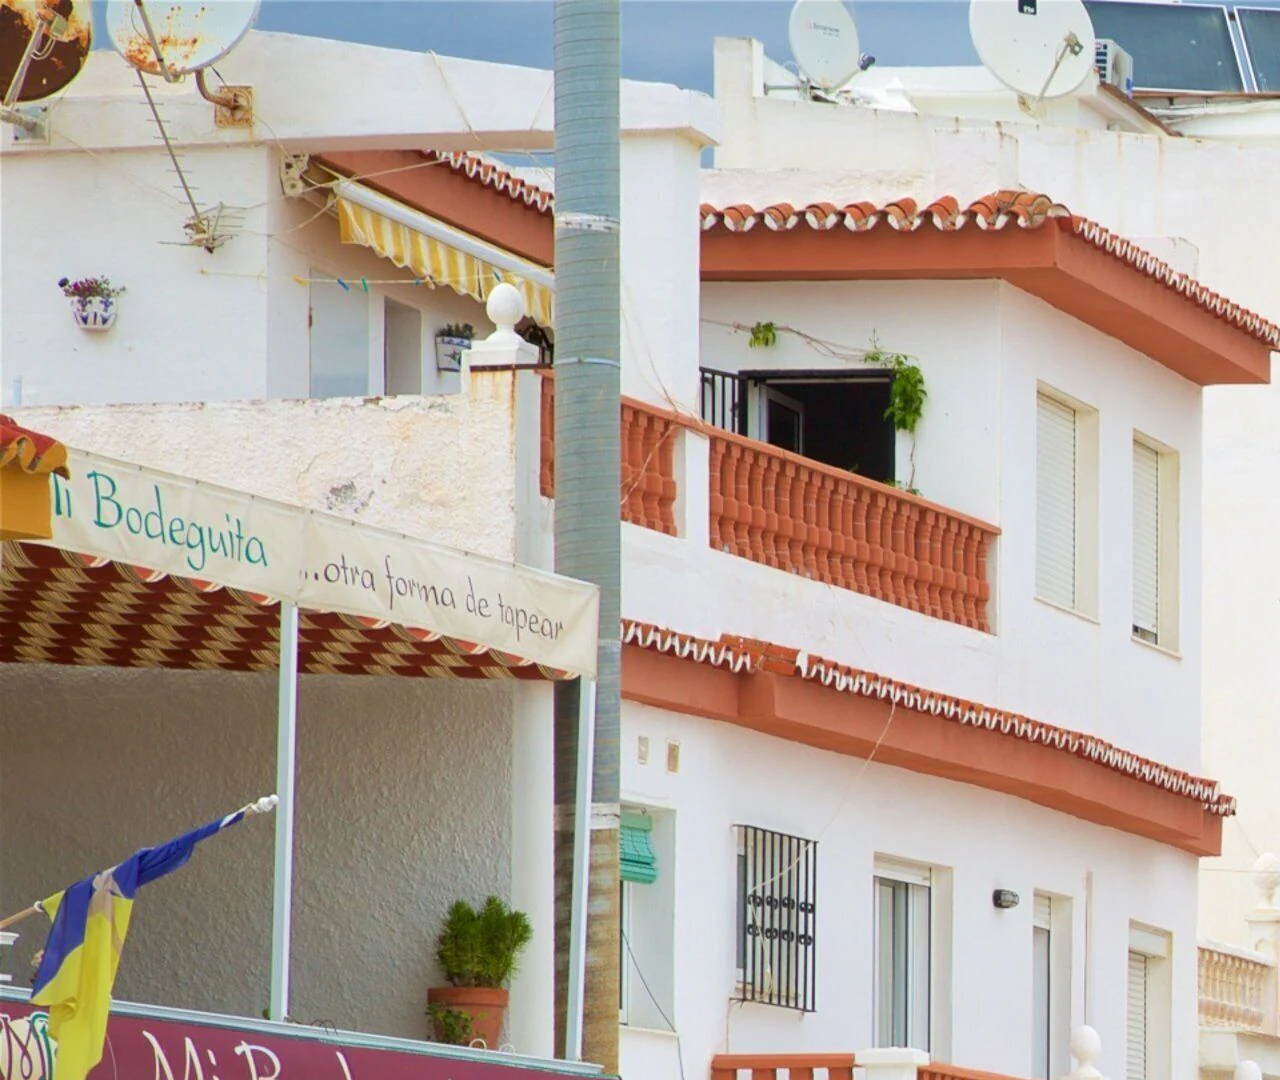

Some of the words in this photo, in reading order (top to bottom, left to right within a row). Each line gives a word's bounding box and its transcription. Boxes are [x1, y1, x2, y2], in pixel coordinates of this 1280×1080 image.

[87, 471, 268, 571] Bodeguita
[385, 555, 456, 610] forma
[466, 576, 492, 618] de
[499, 594, 564, 641] tapear
